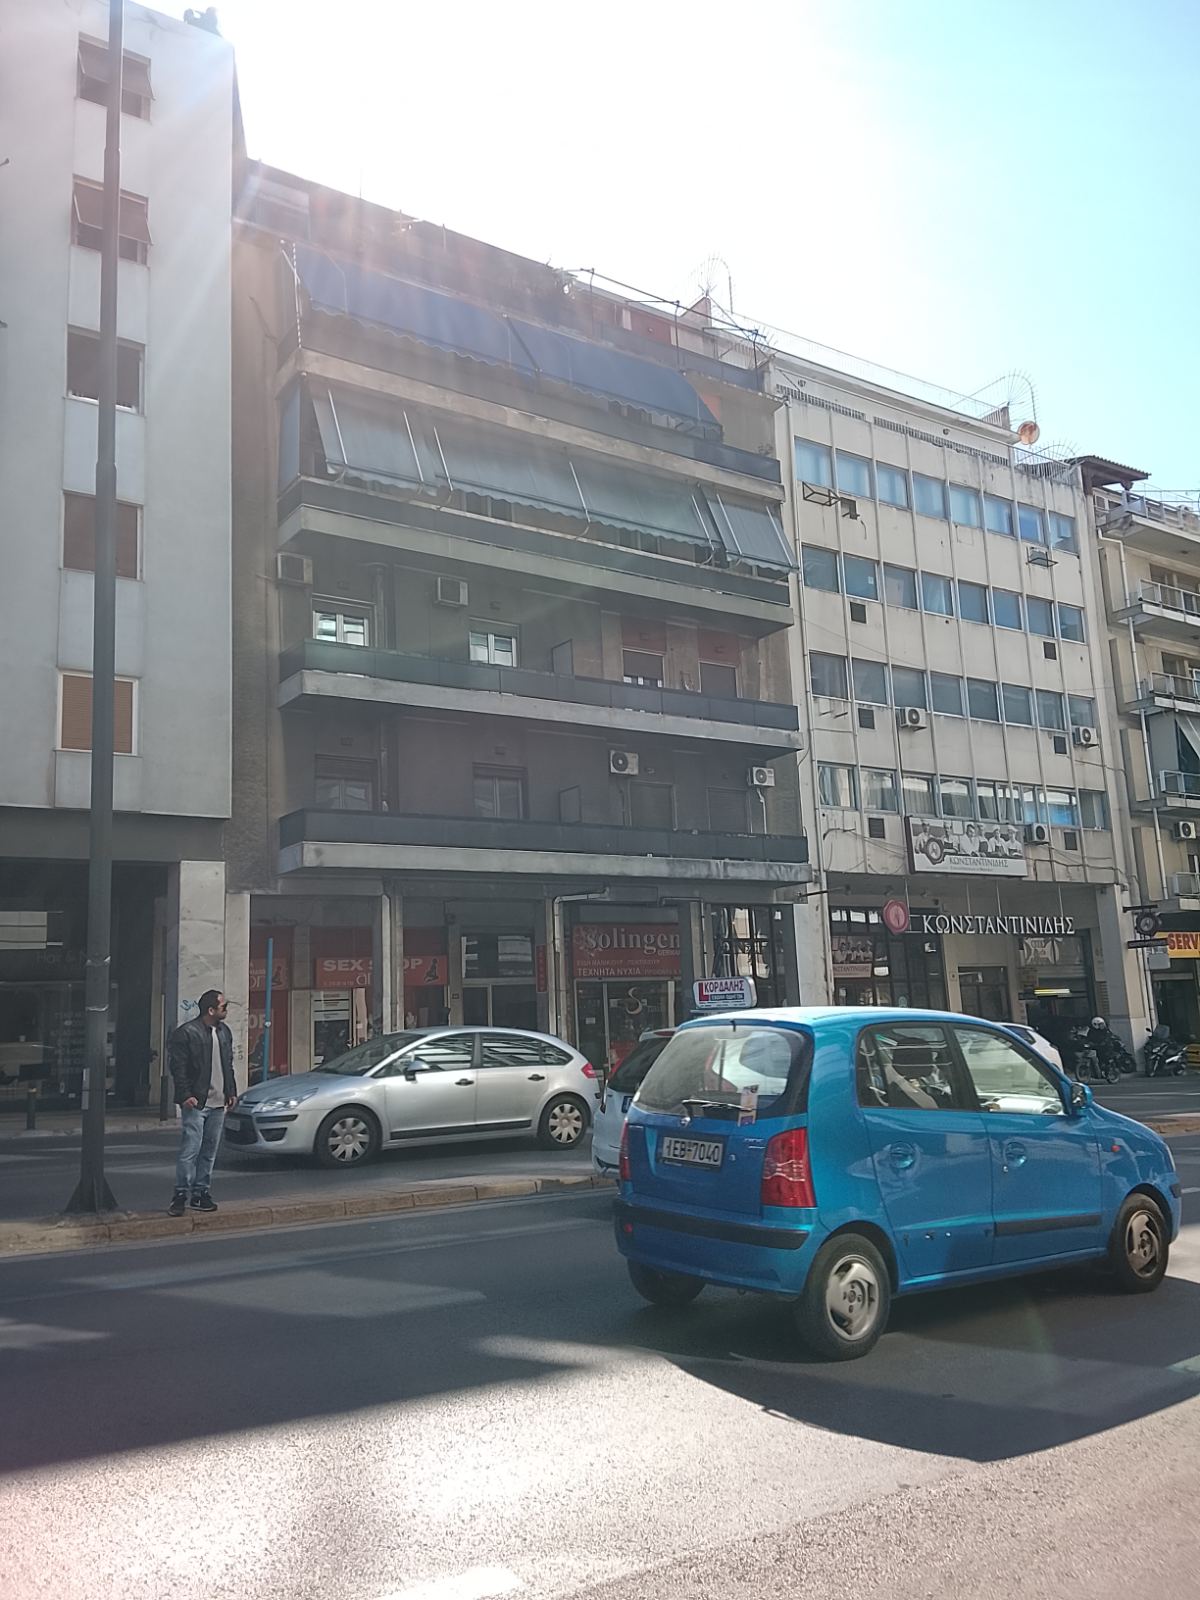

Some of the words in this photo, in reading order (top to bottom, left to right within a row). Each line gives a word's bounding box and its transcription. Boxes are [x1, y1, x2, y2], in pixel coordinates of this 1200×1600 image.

[949, 857, 1009, 868] ΚΩΝΣΤΑΝΤΙΝΙΔΗΣ
[922, 914, 1076, 934] ΚΩΝΣΤΑΝΤΙΝΙΔΗΣ
[1168, 933, 1200, 950] SERV
[322, 959, 364, 972] SEX
[577, 968, 615, 977] ΤΕΧΝΗΤΑ
[616, 967, 641, 976] ΝΥΧΙΑ
[704, 980, 745, 993] ΚΟΡΔΑΛΗΣ
